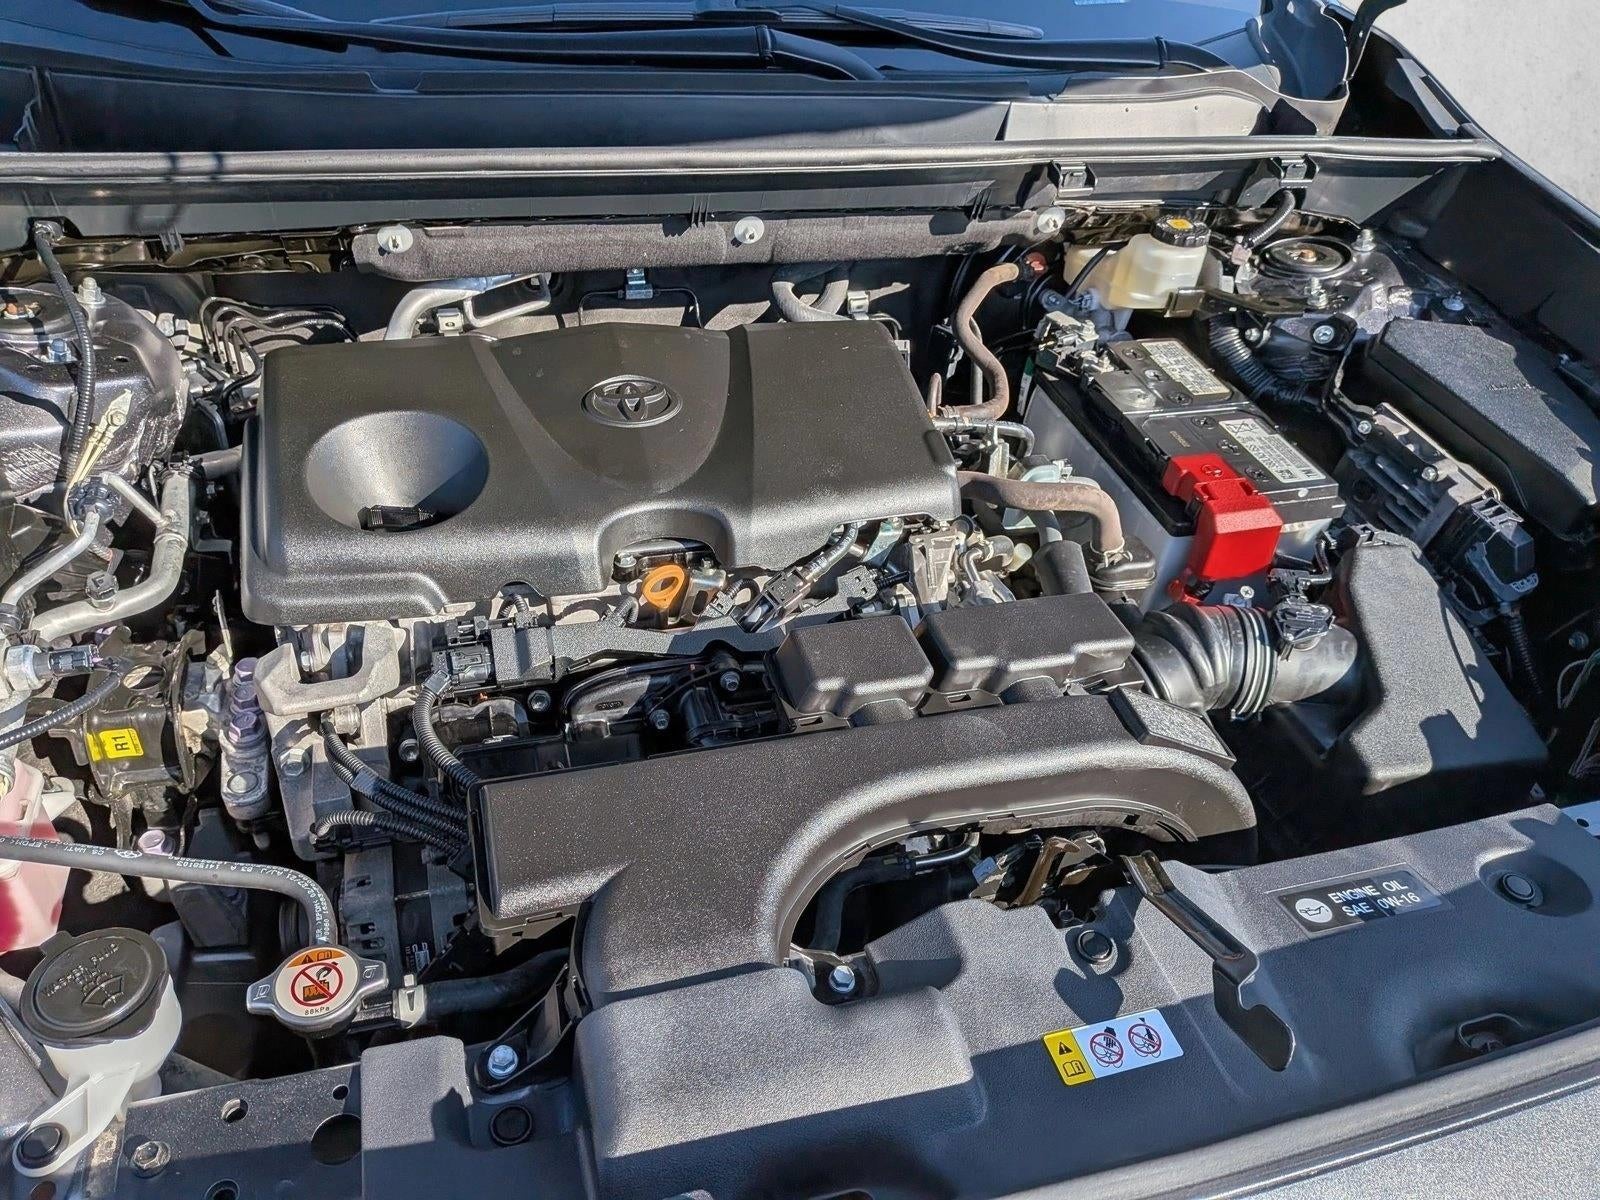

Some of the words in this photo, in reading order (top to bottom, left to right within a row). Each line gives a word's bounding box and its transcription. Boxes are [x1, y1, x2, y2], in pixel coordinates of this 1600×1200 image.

[112, 736, 130, 751] R1
[1327, 885, 1381, 904] ENGINE
[1382, 879, 1409, 893] OIL
[1341, 902, 1374, 917] SAE
[1377, 892, 1421, 909] 0W-16
[304, 1006, 330, 1016] 88kPa
